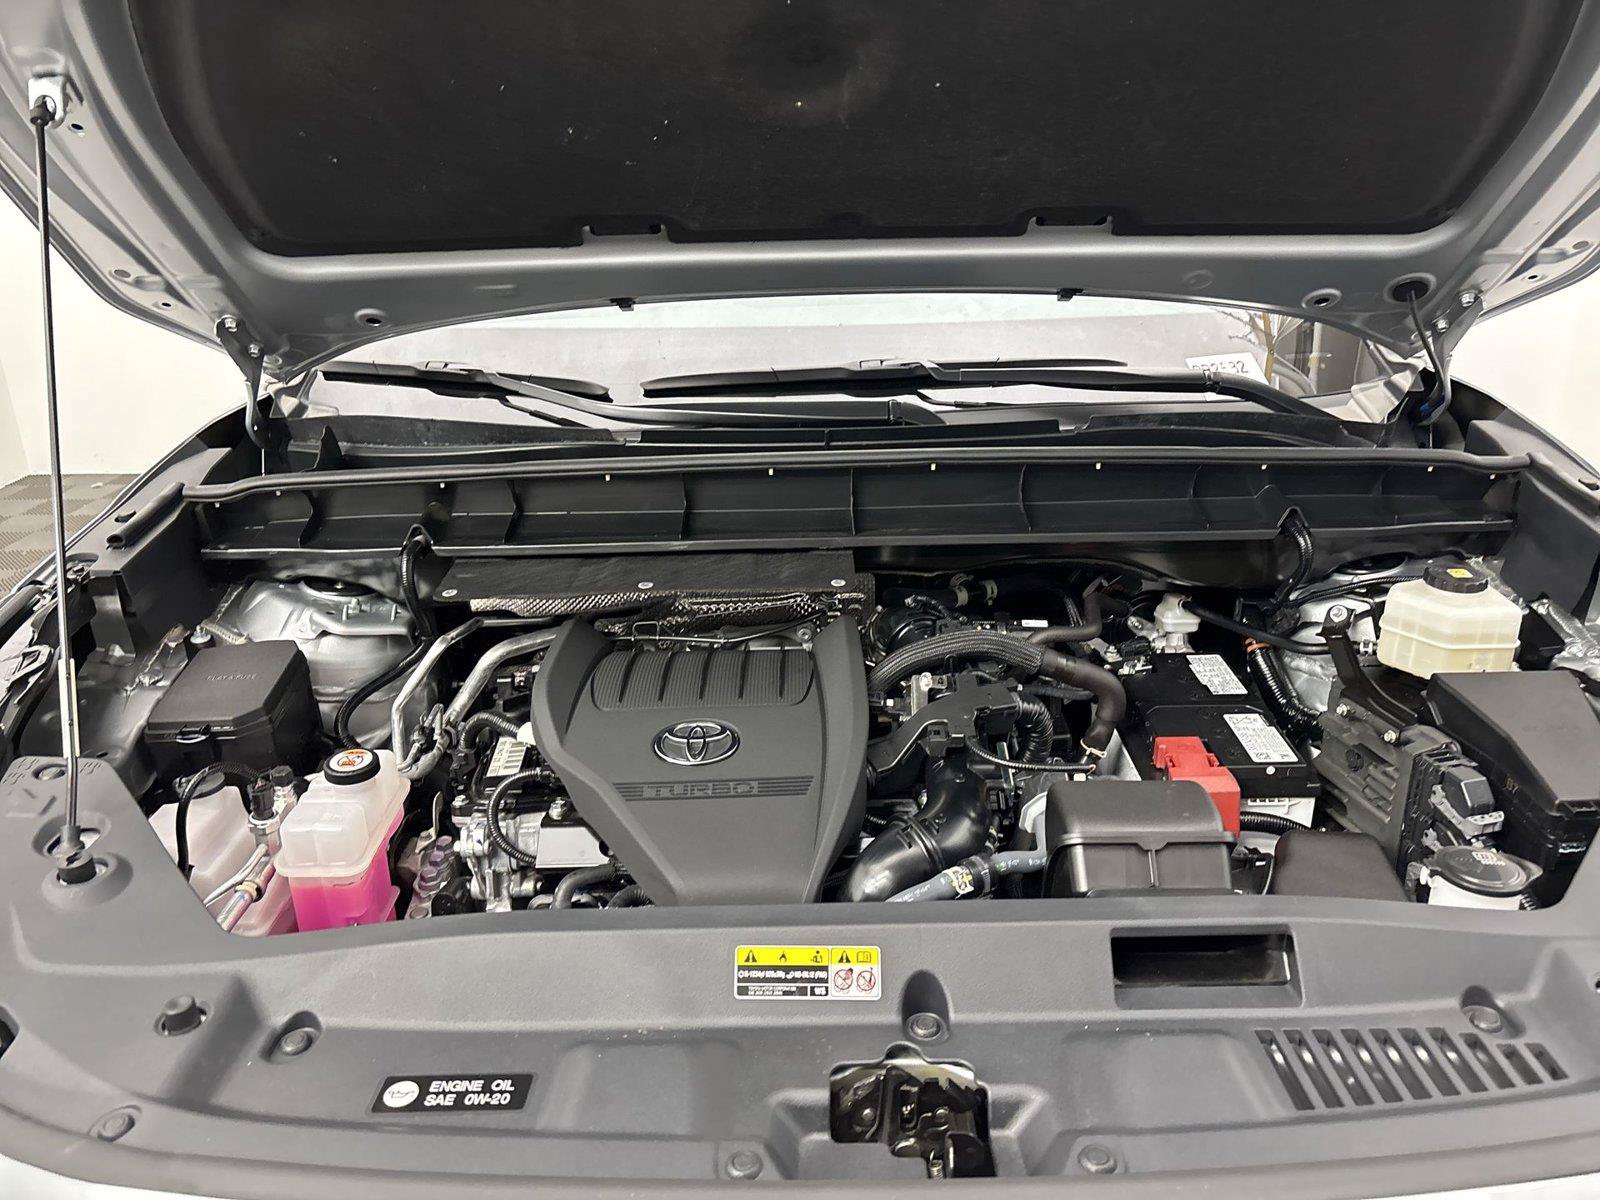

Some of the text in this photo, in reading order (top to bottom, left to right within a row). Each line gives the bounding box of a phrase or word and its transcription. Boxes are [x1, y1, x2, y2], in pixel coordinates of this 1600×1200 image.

[646, 782, 755, 797] TURBO
[429, 1079, 515, 1092] ENGINE OIL
[424, 1093, 511, 1106] SAE 0W-20
